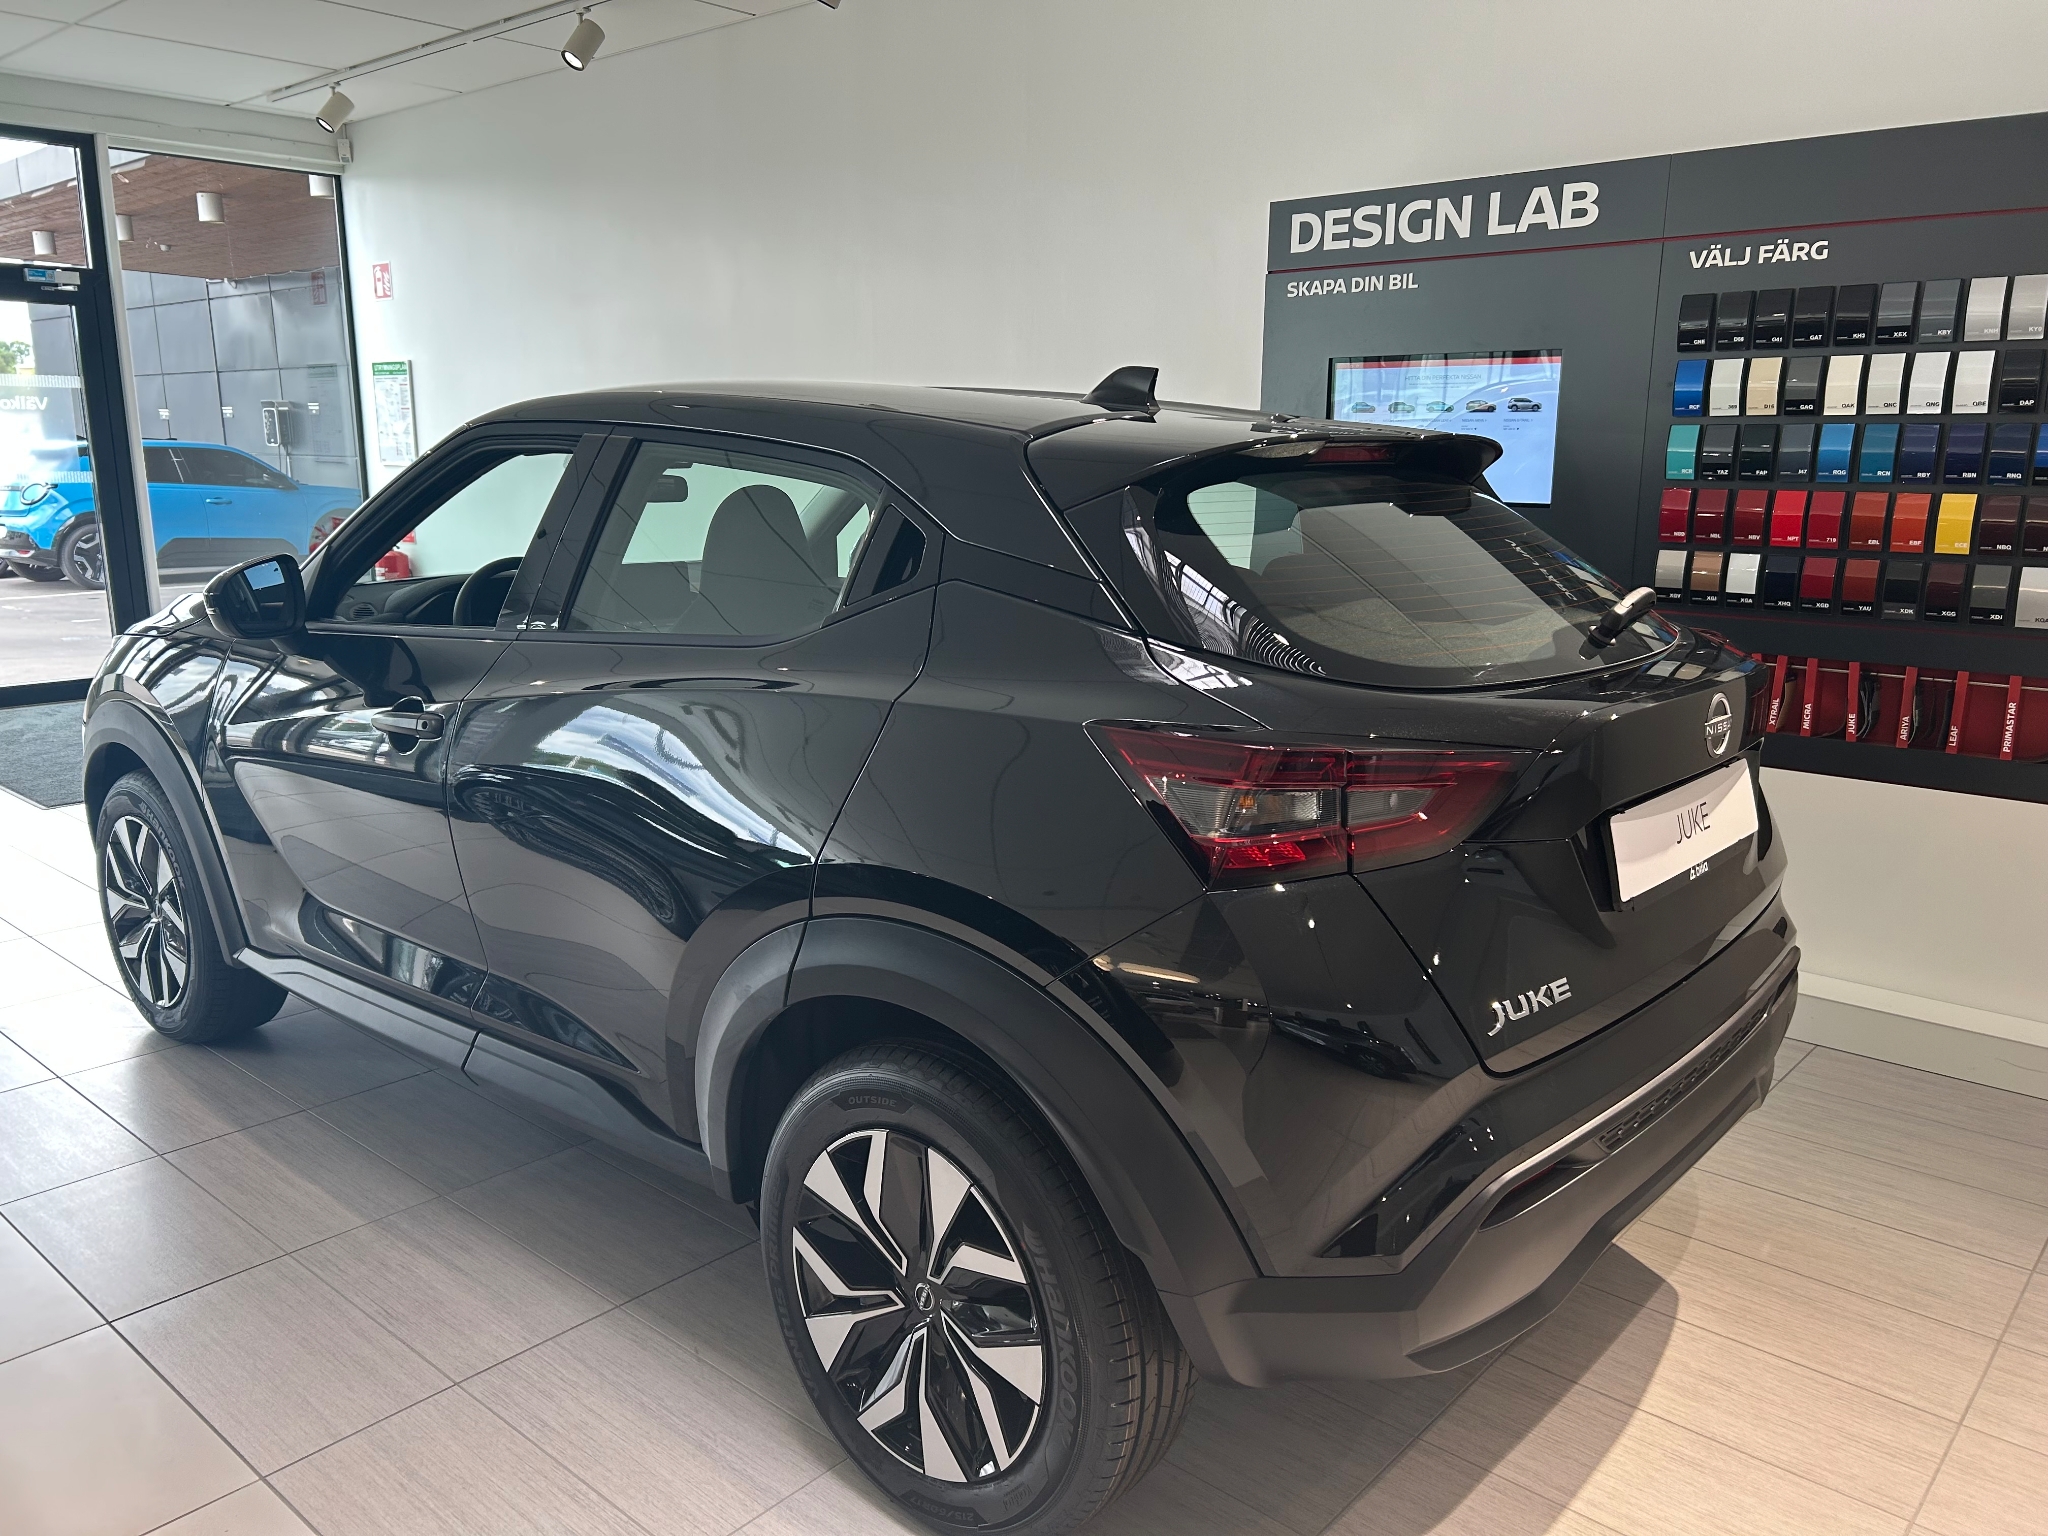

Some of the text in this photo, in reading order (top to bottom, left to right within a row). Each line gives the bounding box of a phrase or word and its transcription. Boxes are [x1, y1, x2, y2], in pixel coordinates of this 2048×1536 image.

[1290, 181, 1599, 254] DESIGN LAB
[1689, 238, 1829, 269] VÄLJ FÄRG
[1287, 272, 1419, 298] SKAPA DIN BIL
[1768, 697, 1780, 725] XTRAIL
[1803, 703, 1812, 729] MICRA
[1706, 719, 1732, 736] NISS
[1899, 715, 1911, 741] ARIYA
[1948, 724, 1959, 747] LEAF
[2002, 701, 2017, 753] PRIMASTAR
[1676, 801, 1711, 845] JUKE
[1487, 976, 1573, 1037] JUKE
[848, 1095, 897, 1108] OUTSIDE
